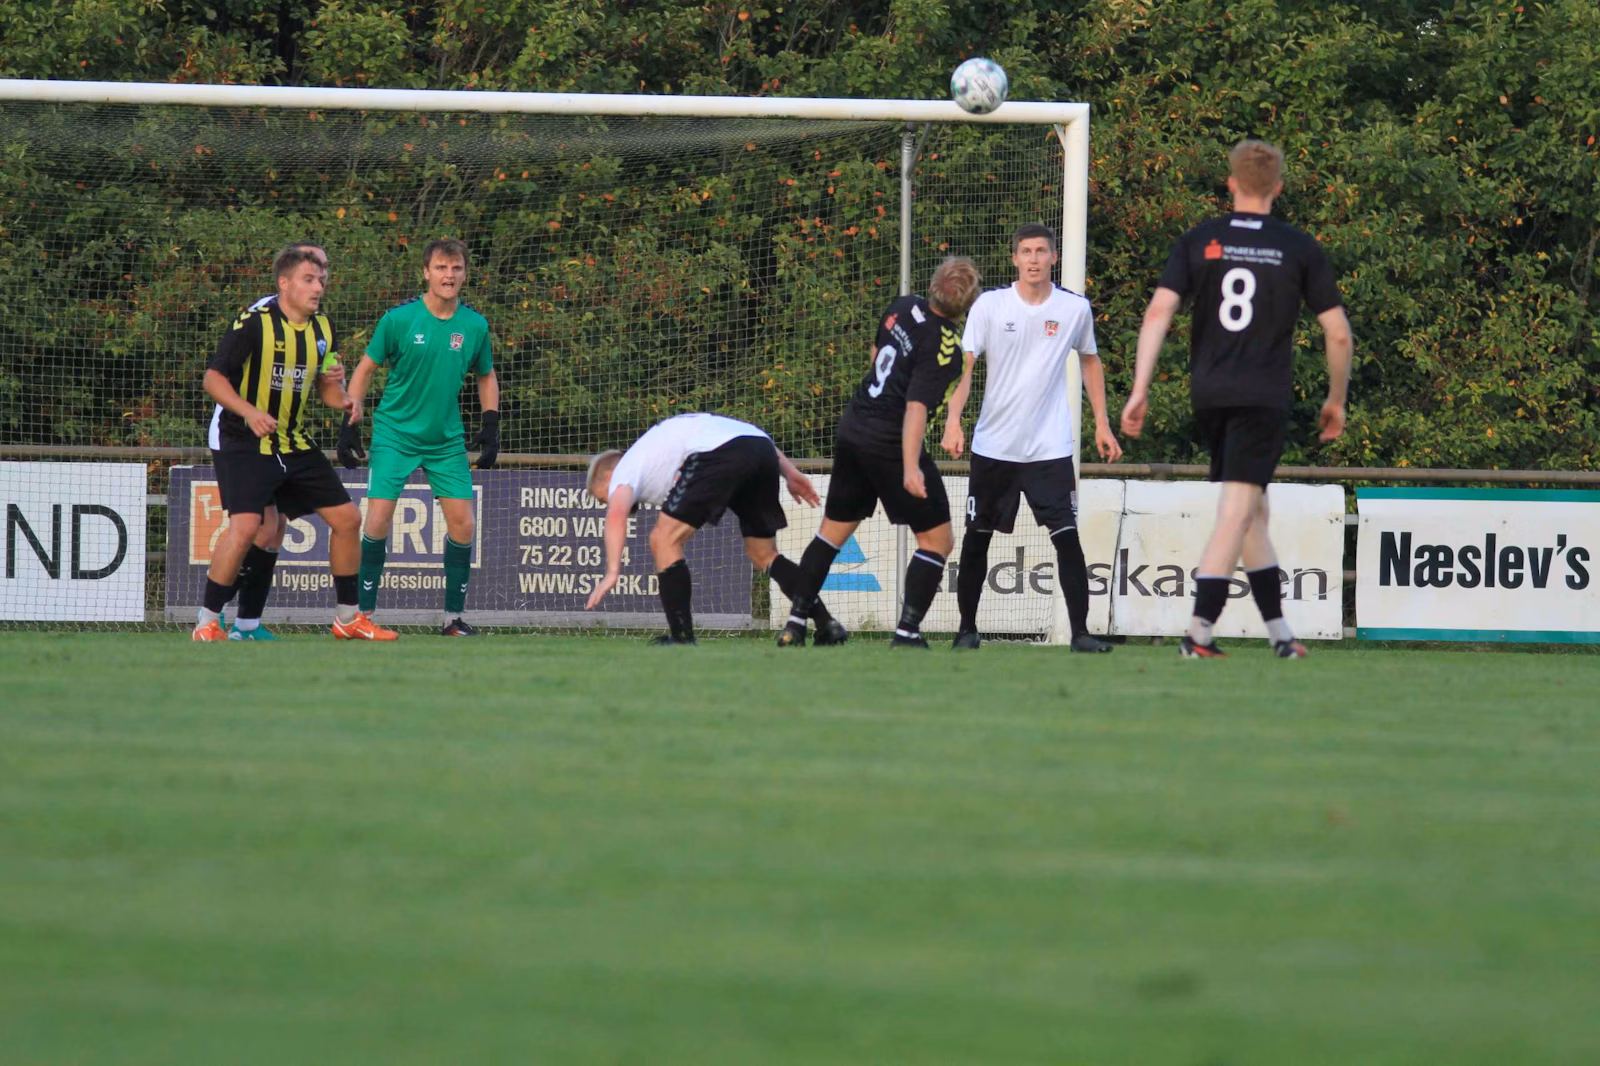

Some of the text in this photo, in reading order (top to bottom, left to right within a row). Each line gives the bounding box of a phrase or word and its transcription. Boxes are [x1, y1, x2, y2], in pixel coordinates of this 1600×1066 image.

[1219, 267, 1256, 332] 8
[868, 344, 897, 398] 9
[6, 503, 128, 580] ND
[519, 516, 567, 538] 6800
[519, 545, 543, 566] 75
[548, 546, 572, 566] 22
[577, 546, 601, 567] 03
[1379, 531, 1591, 591] Næslev's
